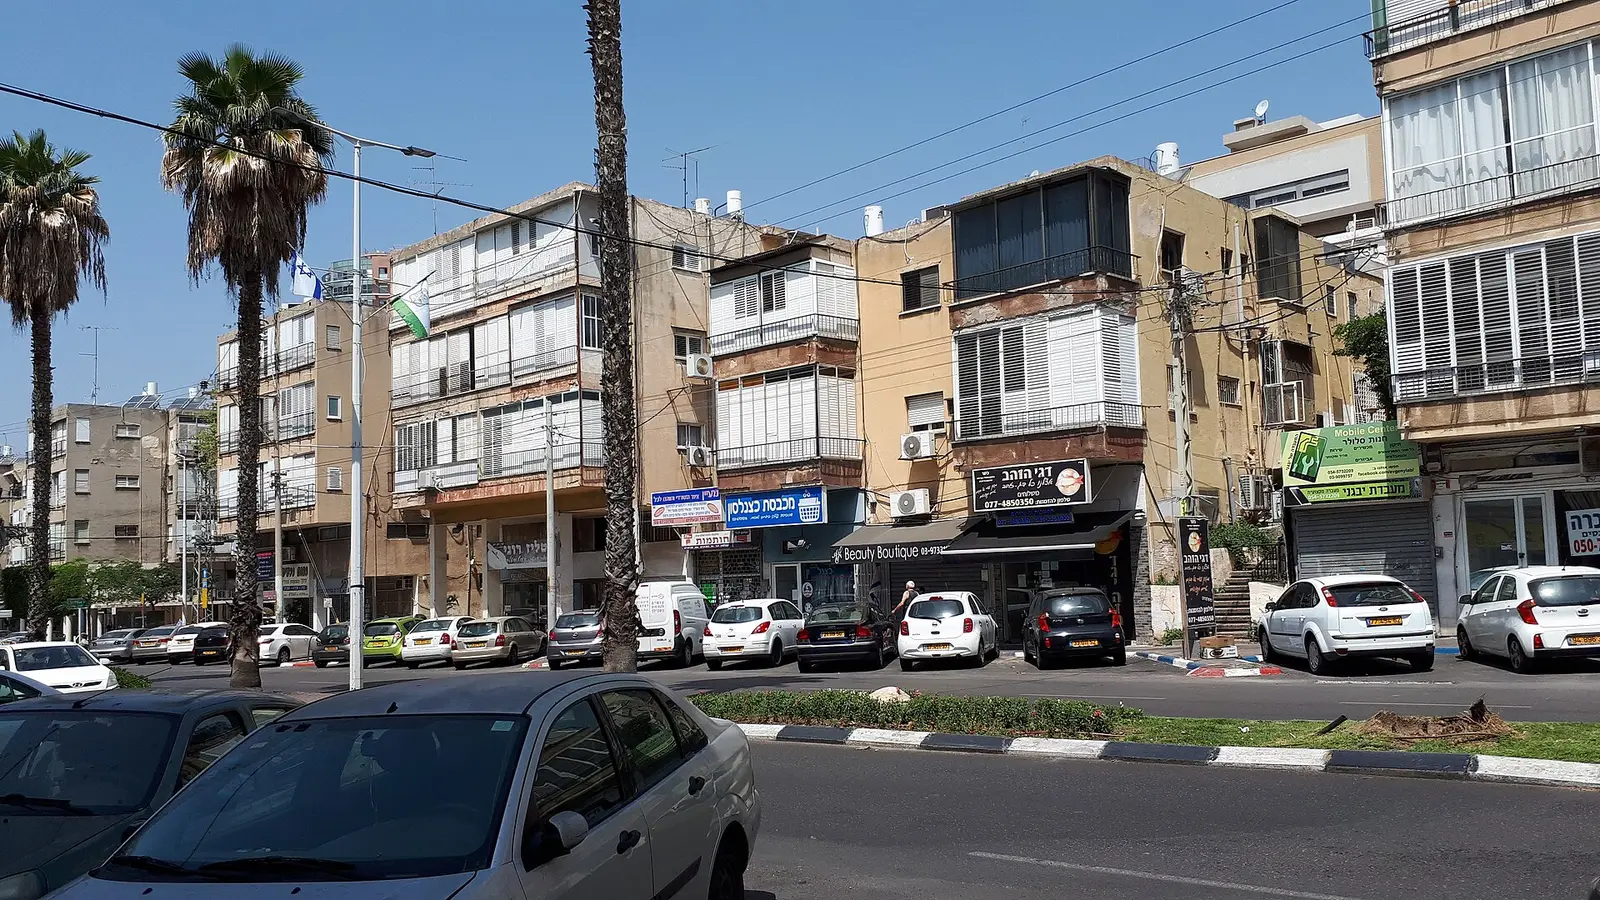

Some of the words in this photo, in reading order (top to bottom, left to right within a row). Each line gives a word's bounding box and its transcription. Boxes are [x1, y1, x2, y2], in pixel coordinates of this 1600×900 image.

[1334, 426, 1365, 437] Mobile
[1342, 437, 1366, 446] סלולר
[1368, 435, 1388, 444] חנות
[1001, 469, 1032, 481] הזהב
[1034, 466, 1053, 477] דגי
[1342, 486, 1366, 497] יבגני
[762, 497, 795, 512] מכבסת
[984, 498, 1034, 508] 077-4850350
[727, 498, 761, 522] כצנלסון
[695, 536, 729, 545] חותמות
[525, 540, 547, 554] טליז
[844, 546, 875, 562] Beauty
[877, 545, 919, 560] Boutique
[1183, 554, 1200, 564] הזהב
[1199, 553, 1209, 563] דגי
